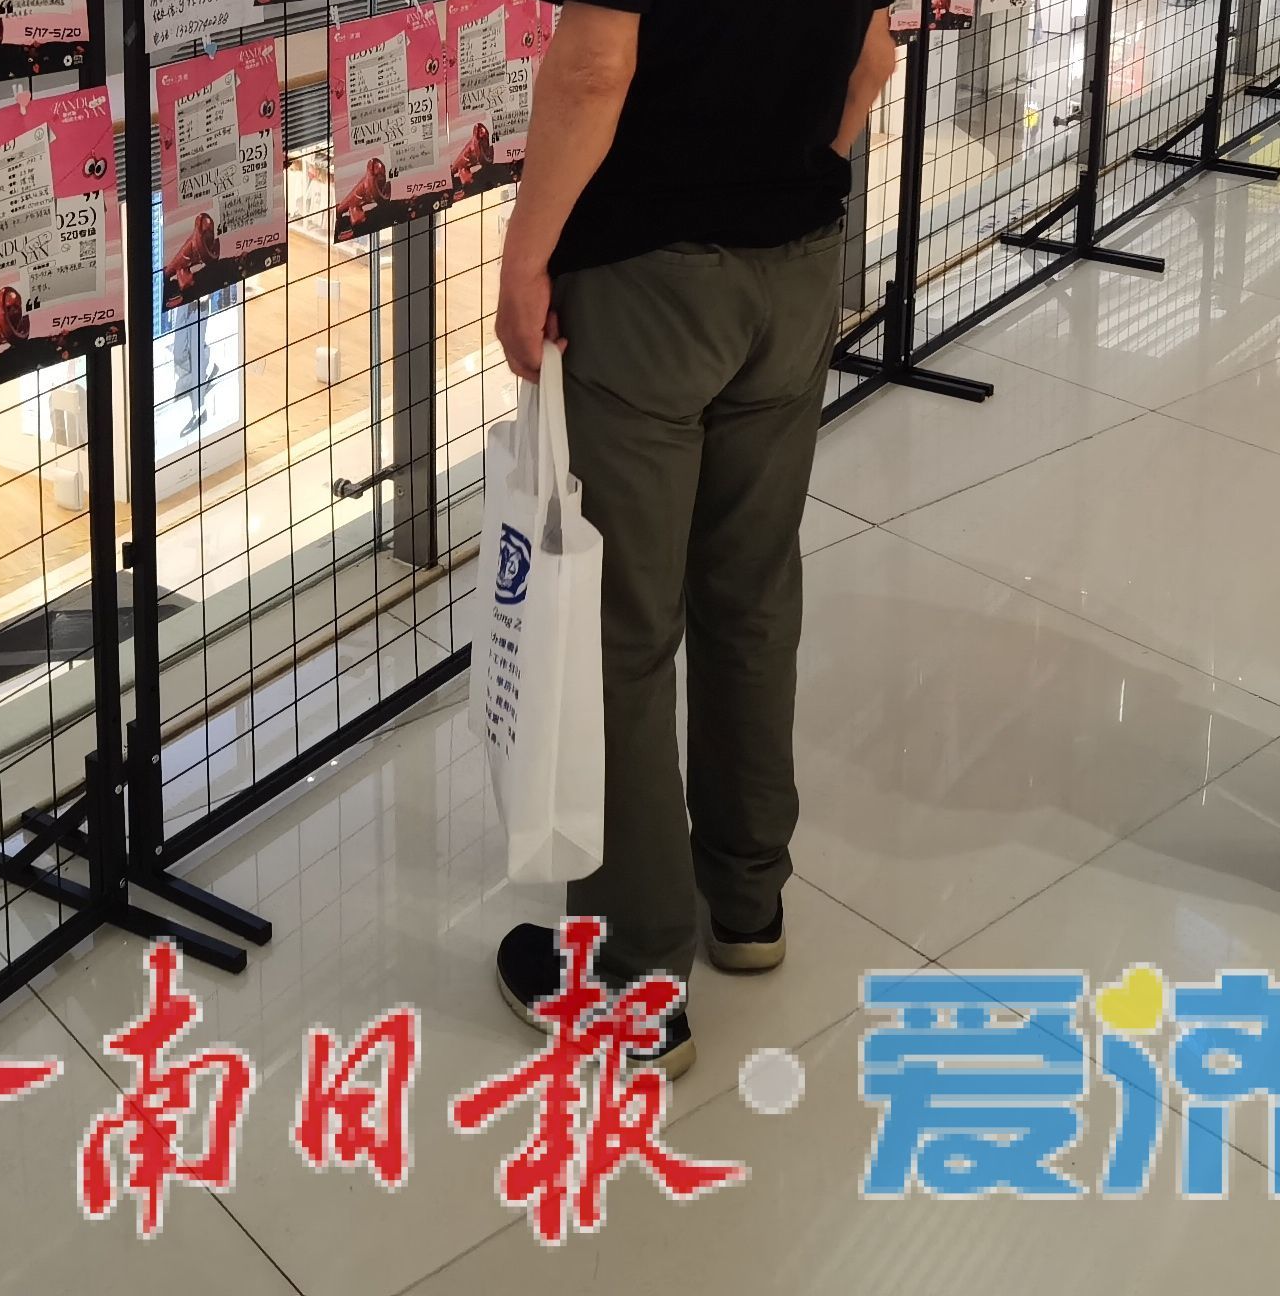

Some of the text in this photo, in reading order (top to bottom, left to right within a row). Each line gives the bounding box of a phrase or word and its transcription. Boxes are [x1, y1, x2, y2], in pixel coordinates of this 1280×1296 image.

[24, 27, 81, 38] 5/17-5/20
[407, 180, 447, 193] 5/17-5/20
[236, 233, 280, 250] 5/17-5/20
[52, 308, 115, 328] 5/17-5/20
